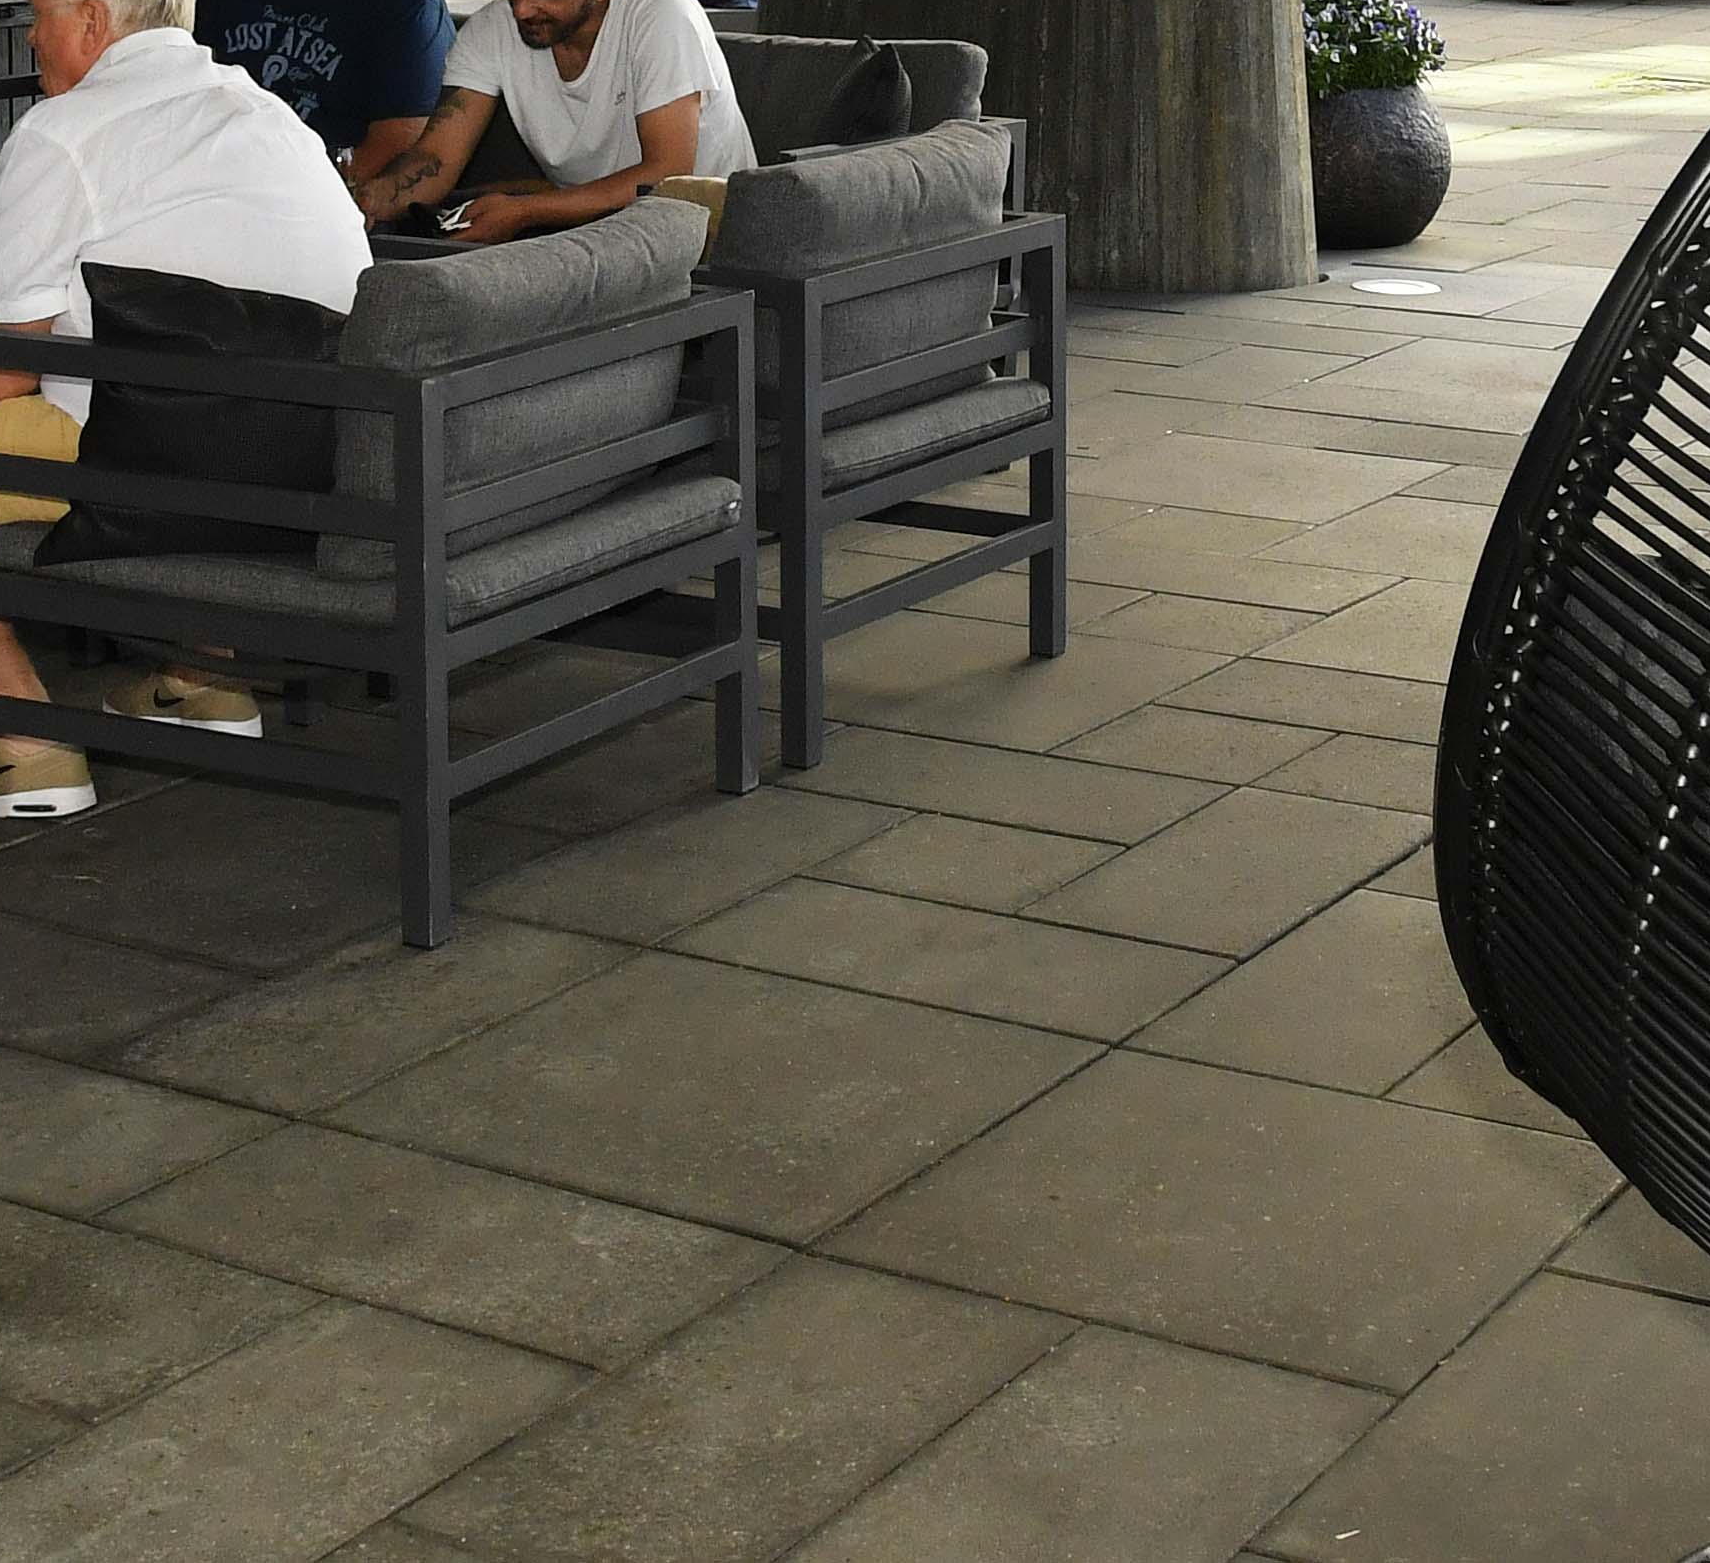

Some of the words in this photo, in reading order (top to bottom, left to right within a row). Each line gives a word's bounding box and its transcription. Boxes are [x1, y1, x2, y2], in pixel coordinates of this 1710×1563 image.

[225, 22, 277, 53] LOST
[277, 26, 313, 59] AT
[303, 37, 343, 81] SEA
